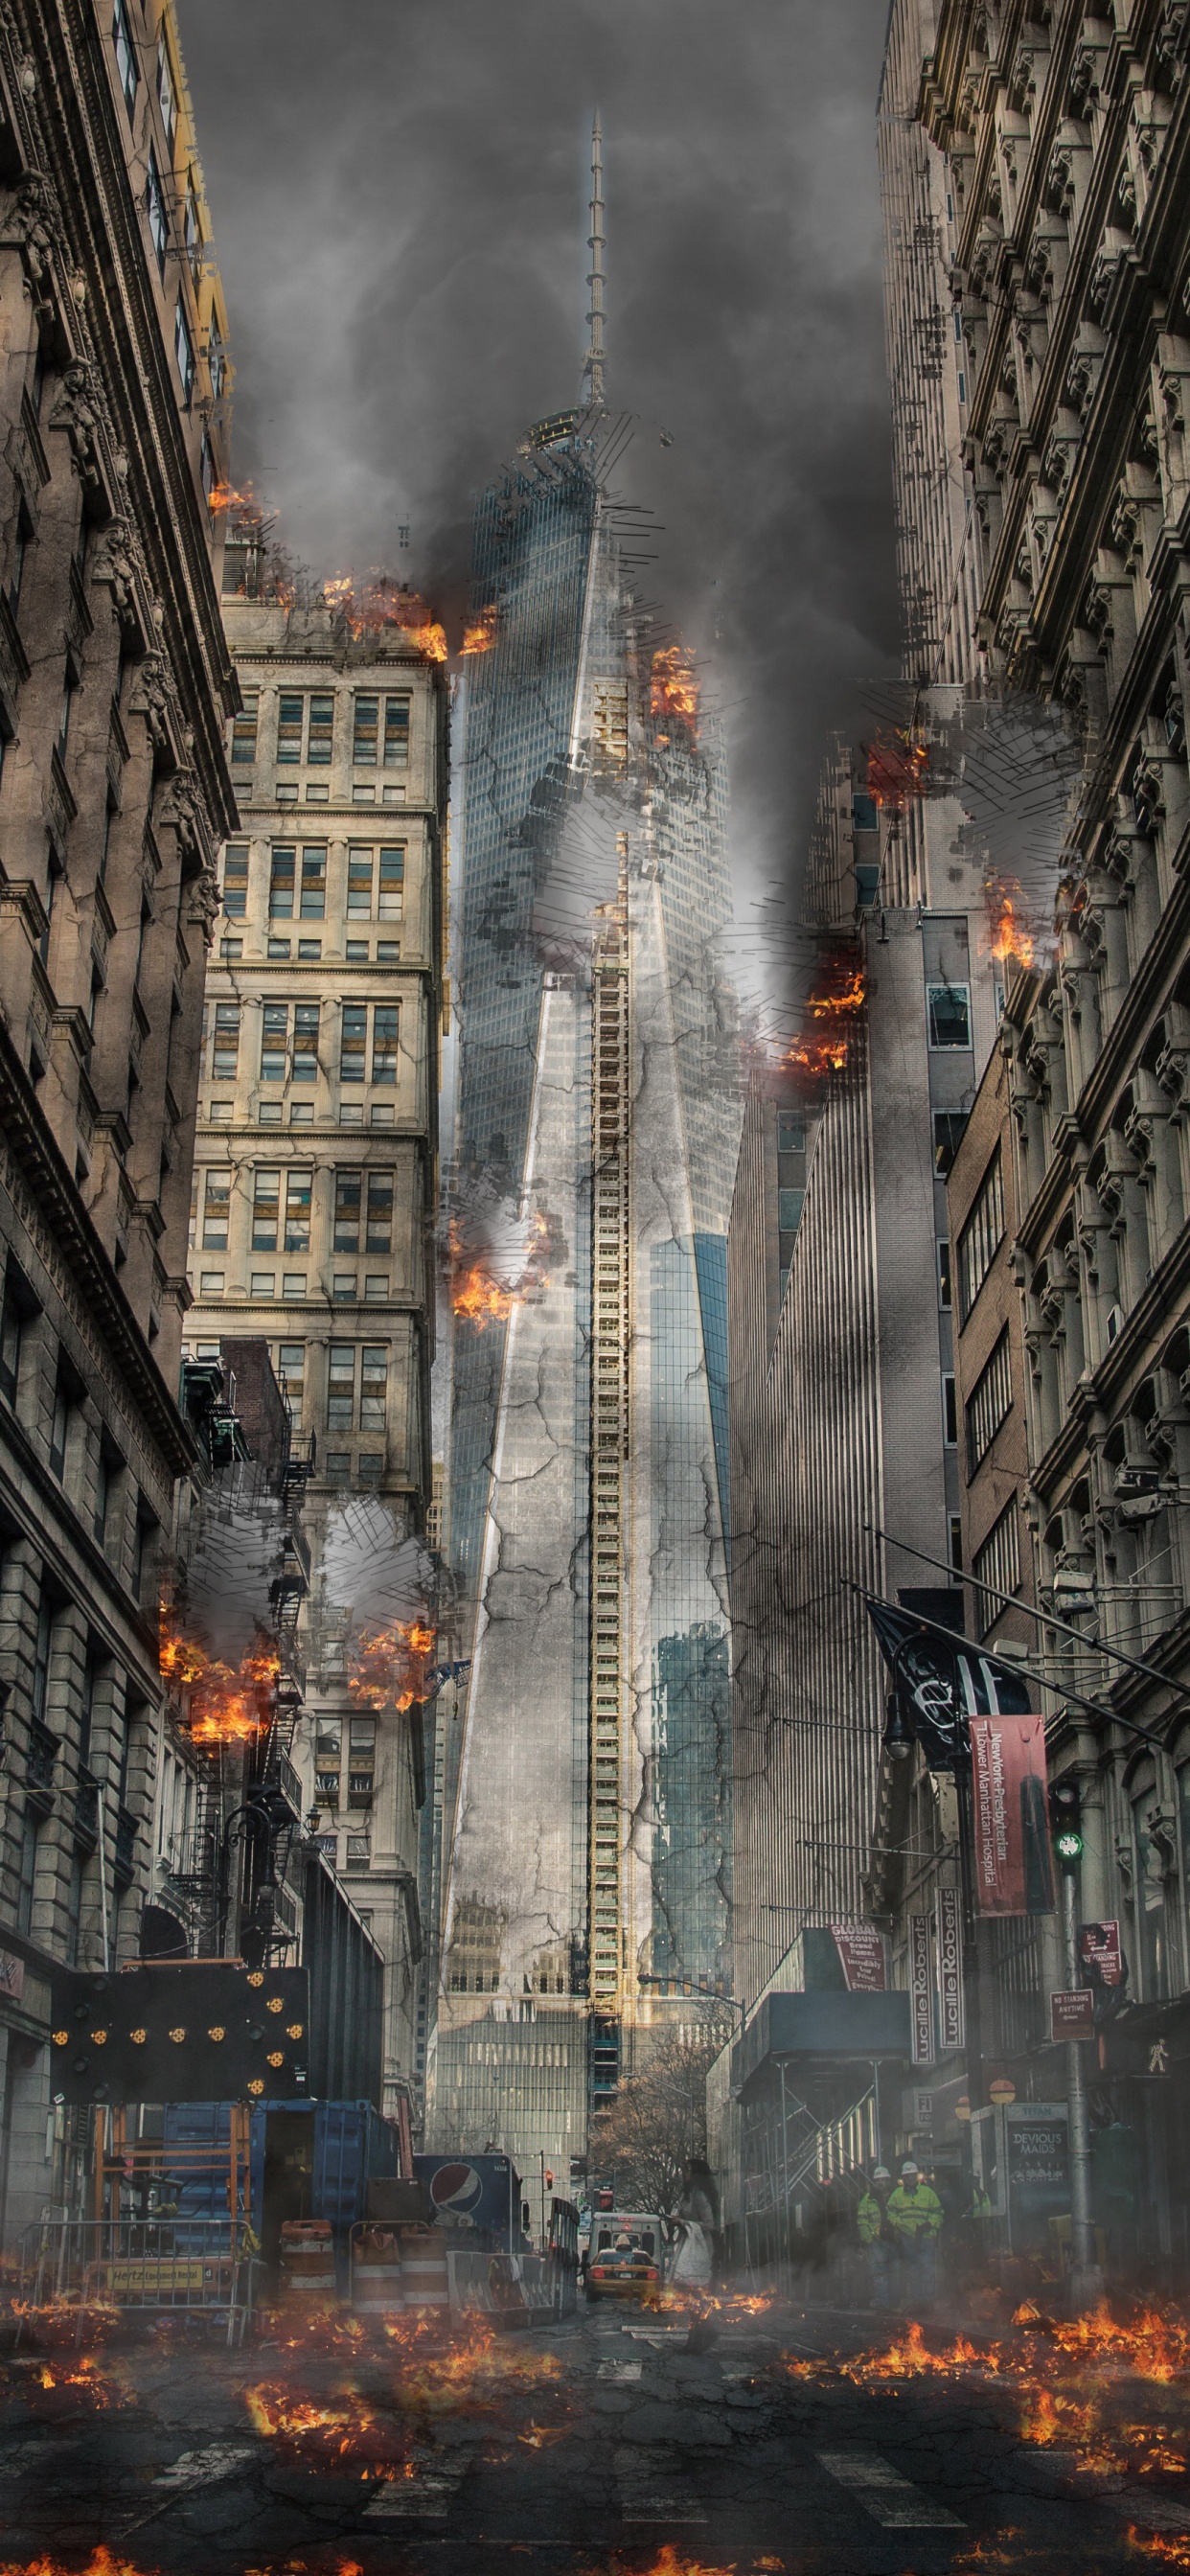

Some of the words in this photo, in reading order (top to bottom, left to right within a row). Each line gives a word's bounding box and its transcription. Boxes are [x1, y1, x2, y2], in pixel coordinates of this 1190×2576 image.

[975, 1734, 988, 1768] Lower
[979, 1771, 994, 1835] Manhattan
[981, 1837, 997, 1887] Hospital
[831, 1924, 879, 1936] GLOBAL
[941, 1890, 956, 1973] Roberts
[913, 1918, 927, 1994] Roberts
[945, 1976, 959, 2046] Lucille
[1058, 2004, 1086, 2013] ANYTIME
[1064, 1994, 1089, 2003] STANDING
[917, 1997, 929, 2061] Lucille
[1013, 2133, 1062, 2145] DEVIOUS
[1020, 2145, 1056, 2154] MAIDS
[113, 2270, 144, 2281] Hertz
